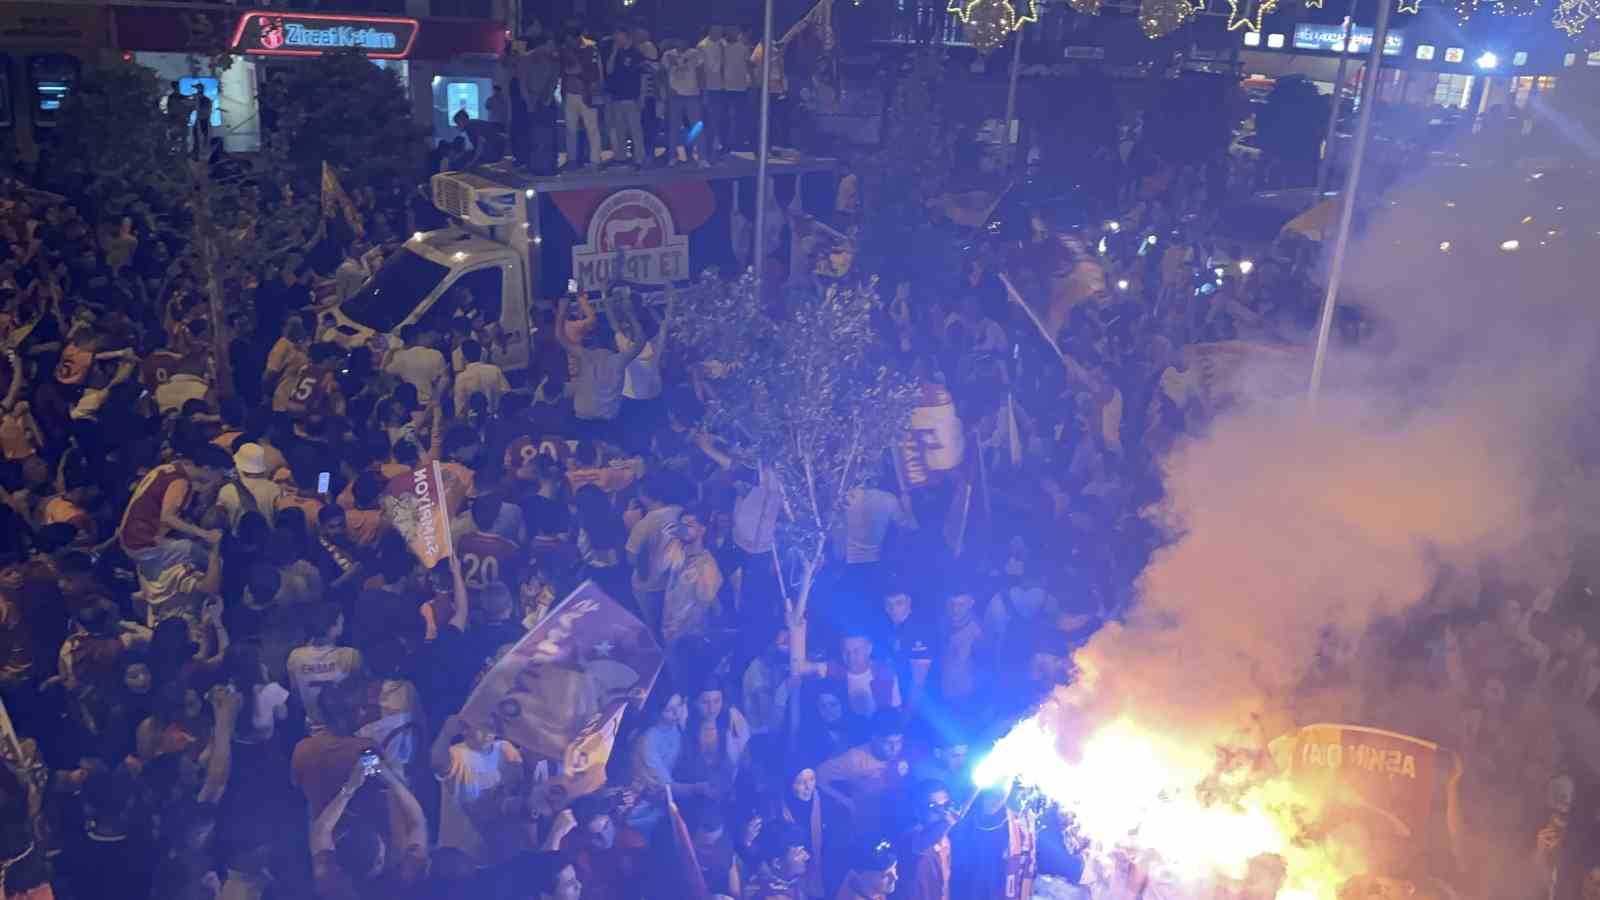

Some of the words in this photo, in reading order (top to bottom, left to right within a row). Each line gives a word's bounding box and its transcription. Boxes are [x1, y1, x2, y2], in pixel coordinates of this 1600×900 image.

[285, 24, 336, 46] Ziraat
[659, 251, 683, 276] ET
[464, 553, 498, 586] 20
